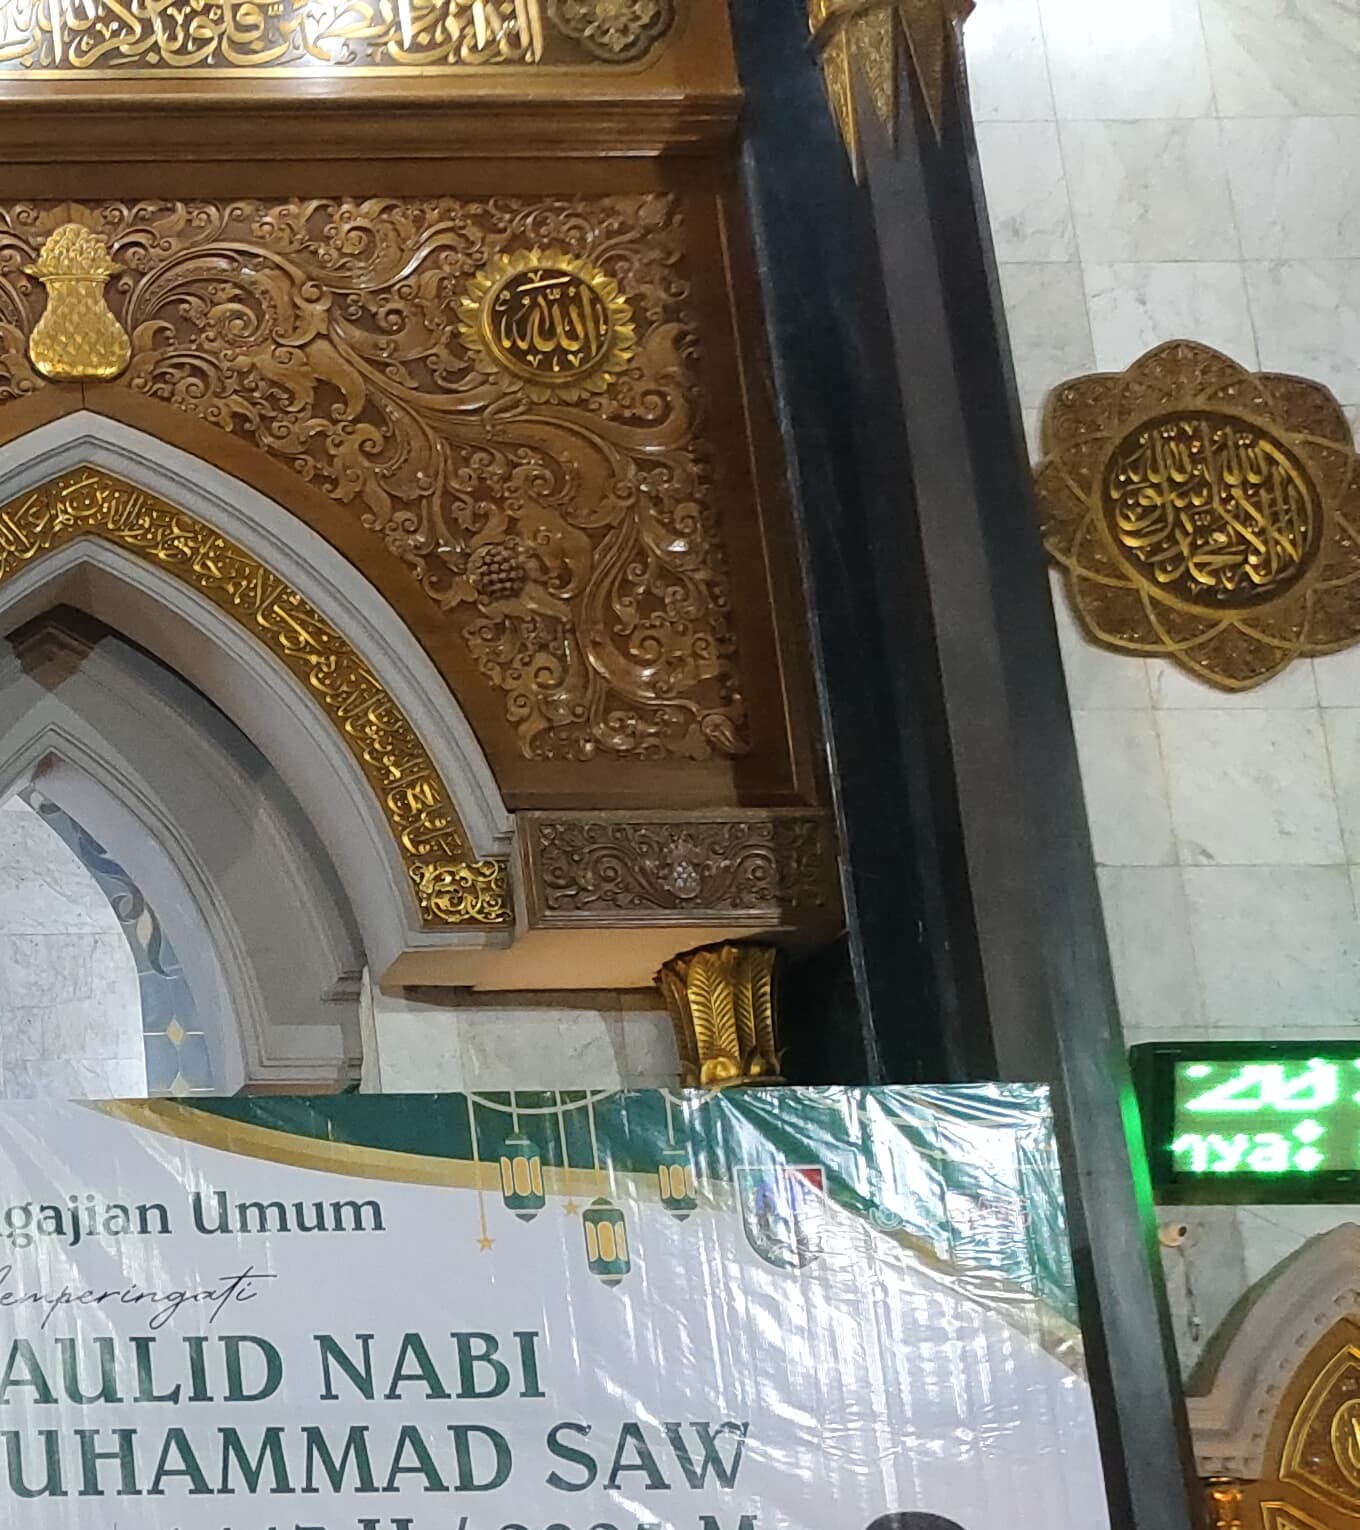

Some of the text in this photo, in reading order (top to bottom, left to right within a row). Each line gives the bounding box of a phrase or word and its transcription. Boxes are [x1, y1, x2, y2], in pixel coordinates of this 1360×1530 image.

[189, 1189, 386, 1234] Umum
[314, 1330, 548, 1402] NABI
[545, 1420, 750, 1493] SAW
